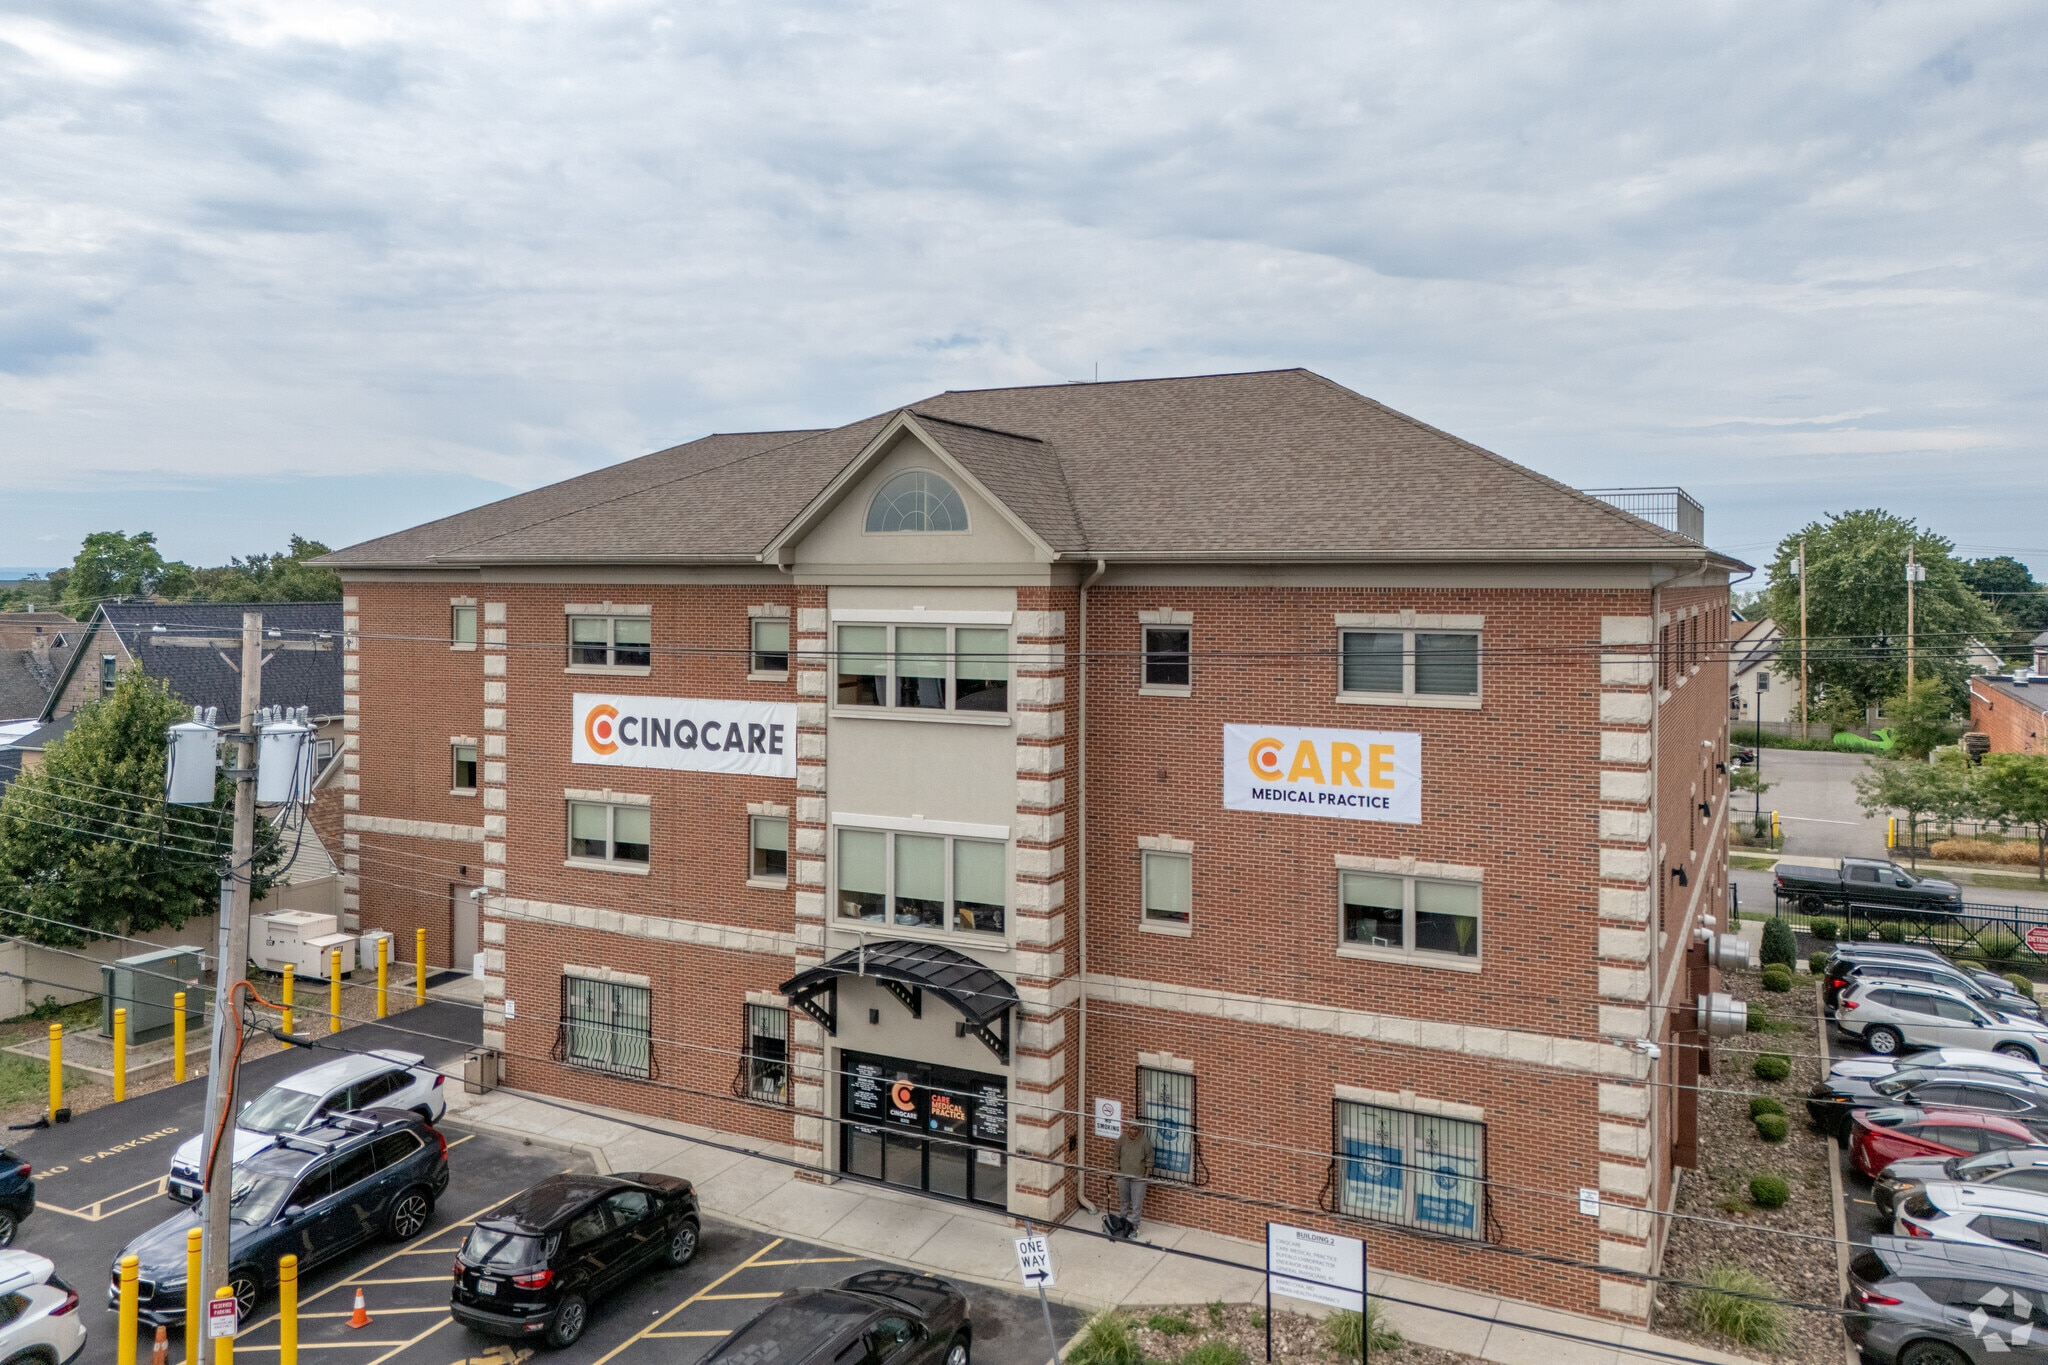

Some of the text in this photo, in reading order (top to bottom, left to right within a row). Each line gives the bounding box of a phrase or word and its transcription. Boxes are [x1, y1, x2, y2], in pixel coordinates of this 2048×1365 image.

[618, 716, 784, 755] CINQCARE
[1248, 737, 1395, 789] CARE
[1252, 787, 1390, 809] MEDICAL PRACTICE
[931, 1094, 951, 1104] CARE
[931, 1101, 963, 1113] MEDICAL
[931, 1107, 966, 1120] PRACTICE
[889, 1109, 918, 1120] CINQCARE
[1097, 1122, 1120, 1132] SMOKING
[30, 1126, 180, 1180] NO PARKING
[1296, 1231, 1329, 1243] BUILDING
[1019, 1241, 1044, 1254] ONE
[1021, 1254, 1046, 1267] WAY
